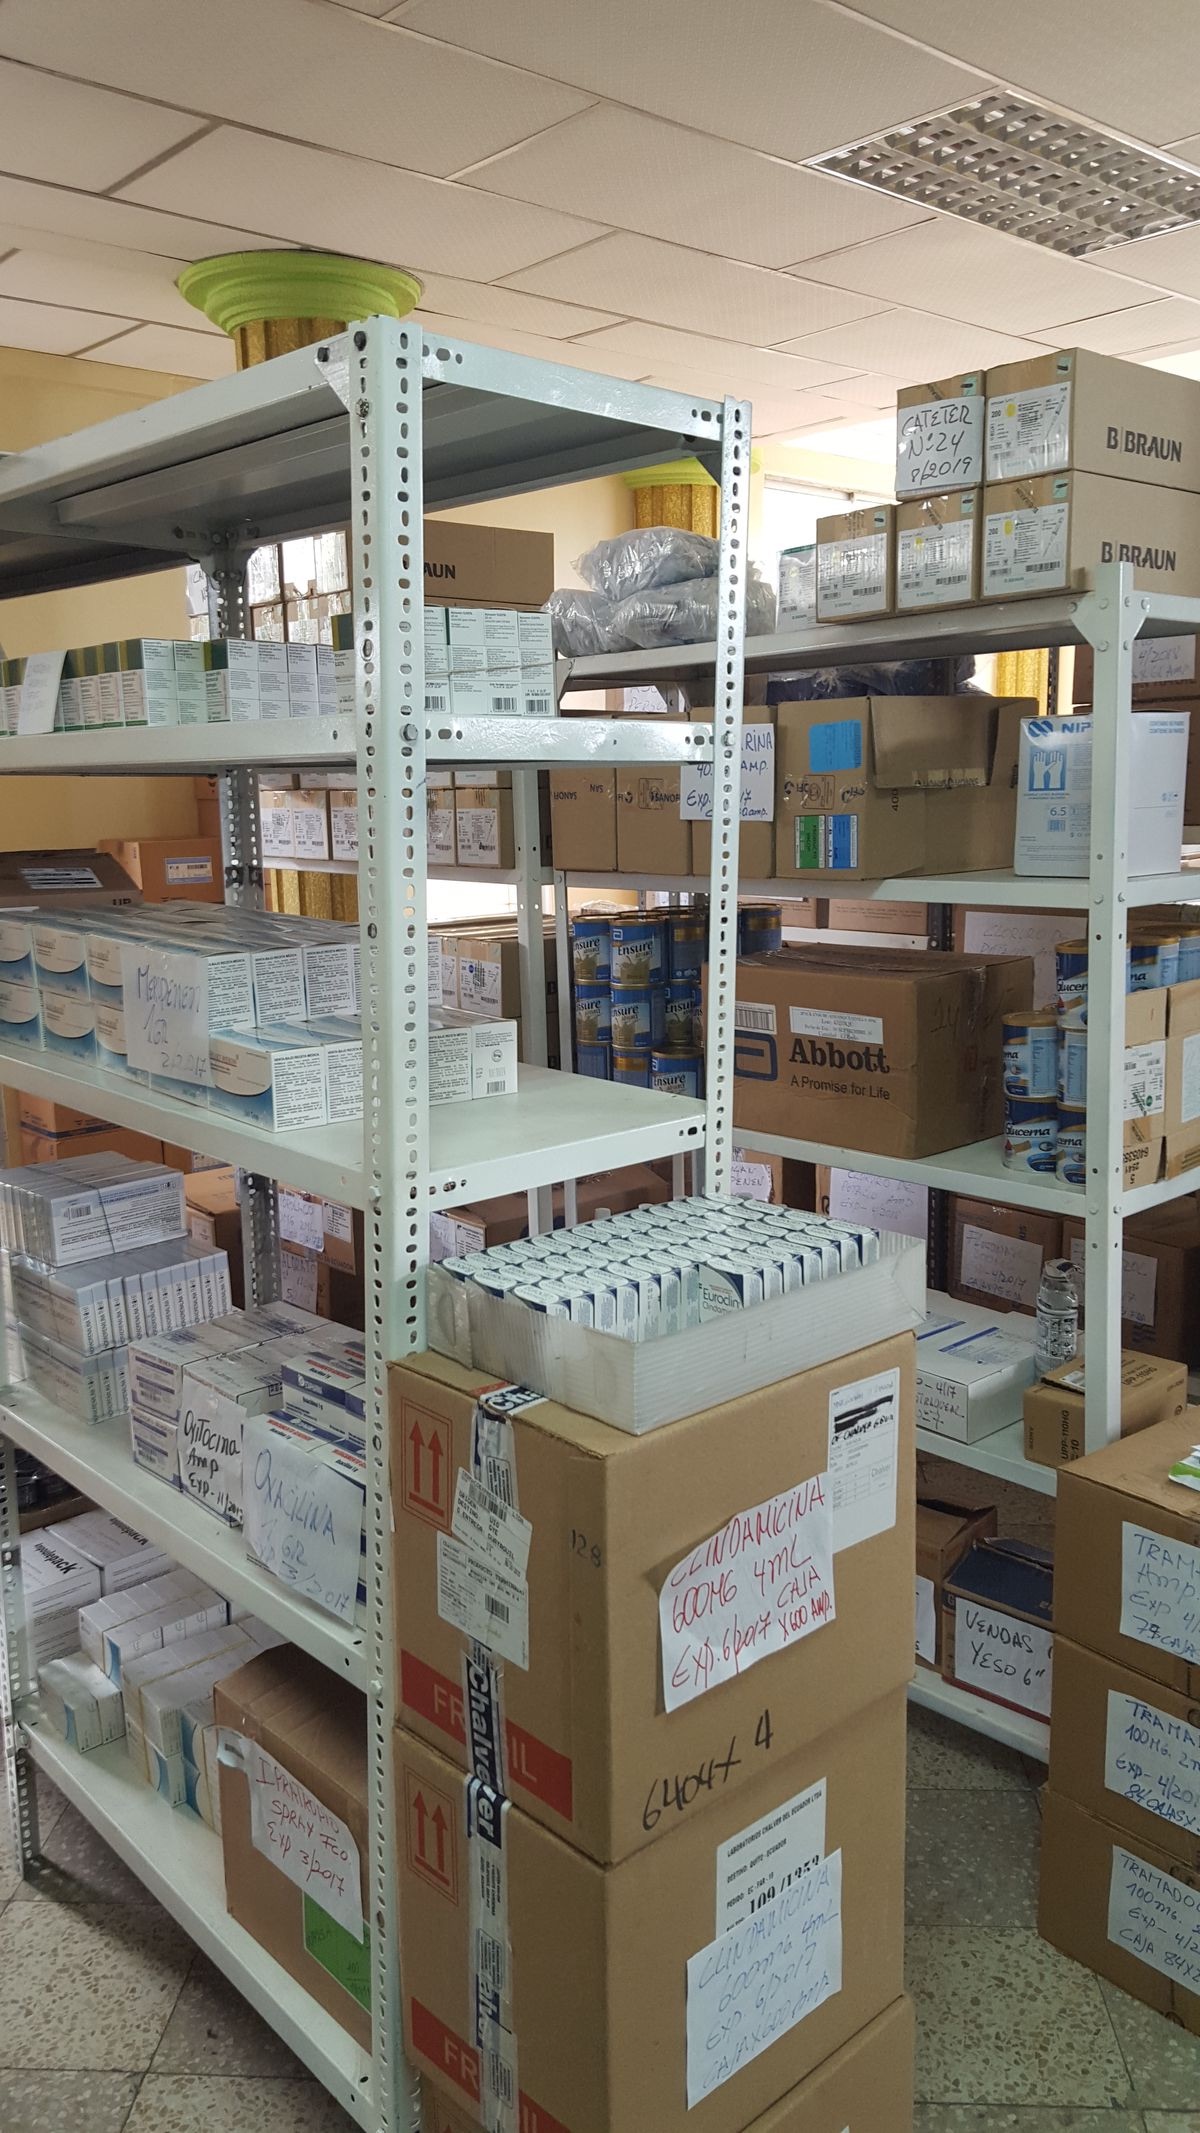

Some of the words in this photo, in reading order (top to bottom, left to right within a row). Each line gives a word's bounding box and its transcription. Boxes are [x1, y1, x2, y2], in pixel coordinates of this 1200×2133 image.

[902, 404, 972, 436] CATETER
[1106, 426, 1118, 449] B
[1124, 430, 1182, 463] BRAUN
[911, 456, 973, 485] 8/2019
[1119, 544, 1176, 572] BRAUN
[1062, 721, 1093, 733] NIP
[1050, 806, 1067, 817] 6.5
[618, 940, 653, 956] Ensure
[789, 1038, 890, 1074] Abbott
[653, 1074, 686, 1088] Ensure
[791, 1075, 799, 1087] A
[801, 1076, 848, 1094] Promise
[851, 1083, 866, 1096] for
[869, 1085, 890, 1100] Life
[1005, 1122, 1050, 1137] Glucerna
[671, 1476, 826, 1587] CLINDAMICINA
[1134, 1534, 1200, 1578] TRAM
[777, 1565, 821, 1608] CAJA
[1130, 1591, 1171, 1616] Exp
[966, 1610, 1033, 1653] VENDAS
[972, 1641, 1016, 1676] YESO
[1125, 1699, 1200, 1748] TRAMA
[272, 1800, 313, 1838] SPRAY
[728, 1830, 761, 1858] LABORATORIOS
[762, 1816, 782, 1835] CHALVER
[782, 1811, 790, 1822] DEL
[791, 1797, 811, 1816] ECUADOR
[300, 1849, 345, 1896] 3/2017
[1120, 1928, 1154, 1954] CAJA
